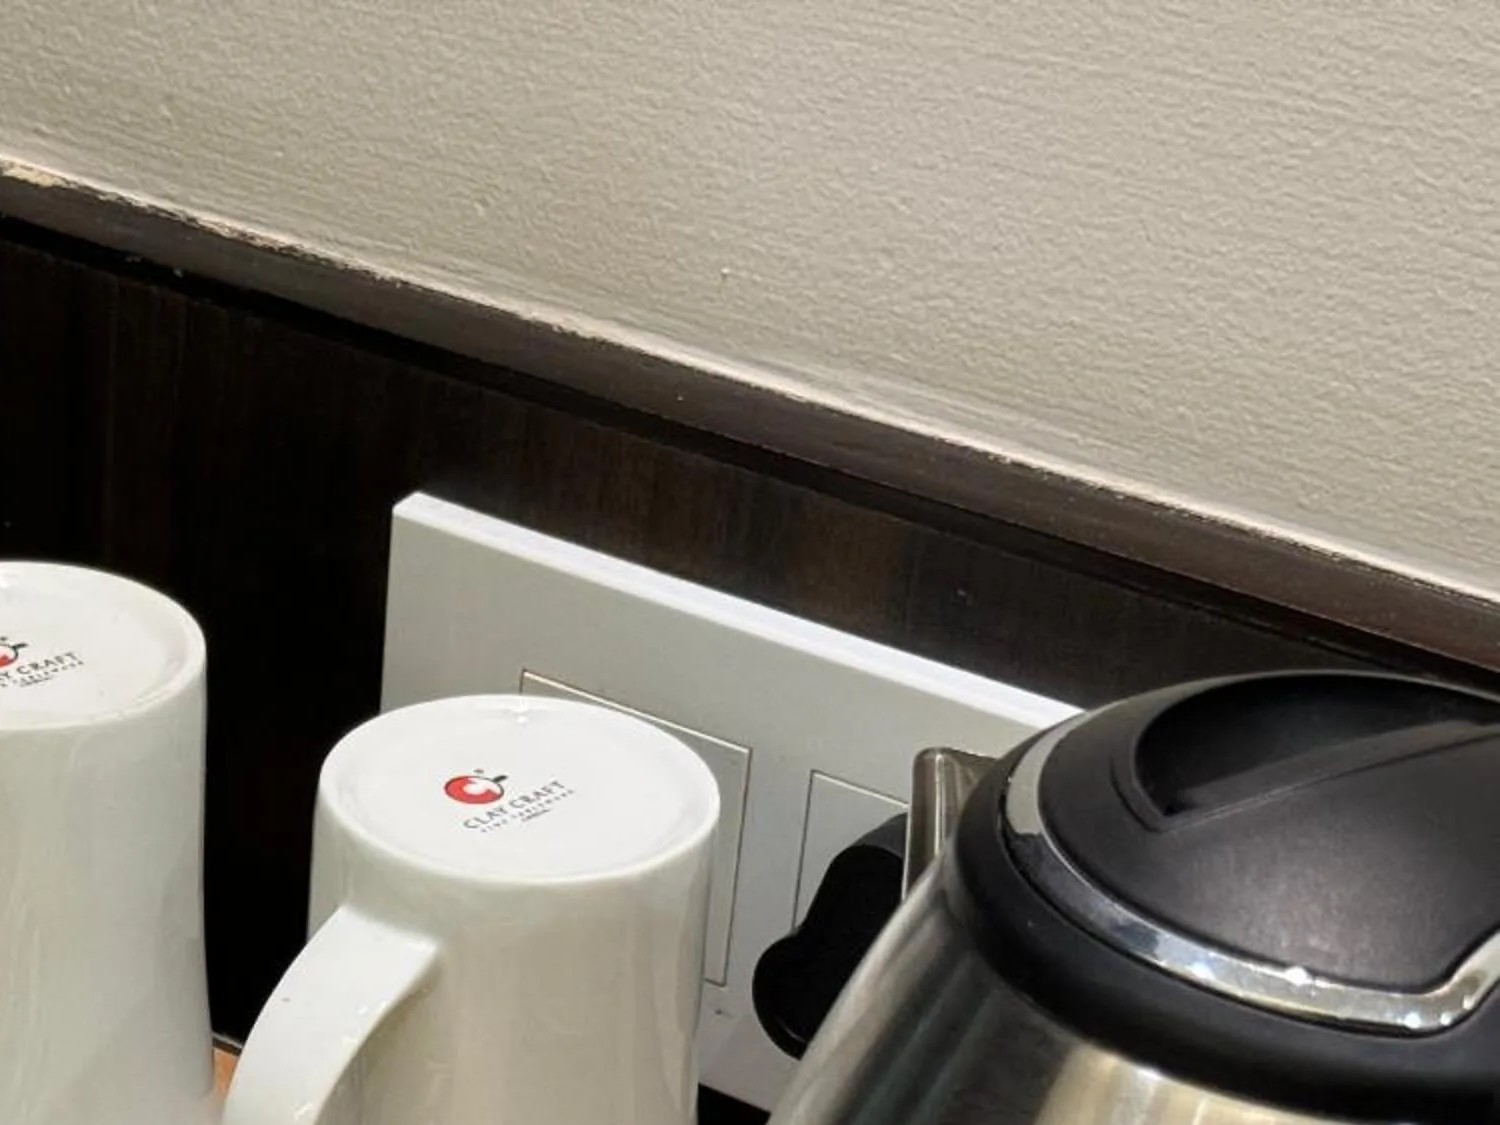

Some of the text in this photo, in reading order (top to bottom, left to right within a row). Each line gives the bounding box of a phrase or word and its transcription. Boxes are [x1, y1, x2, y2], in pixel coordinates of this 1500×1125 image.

[16, 652, 80, 676] CRAFT
[463, 806, 508, 829] CLAY
[508, 780, 566, 809] CRAFT
